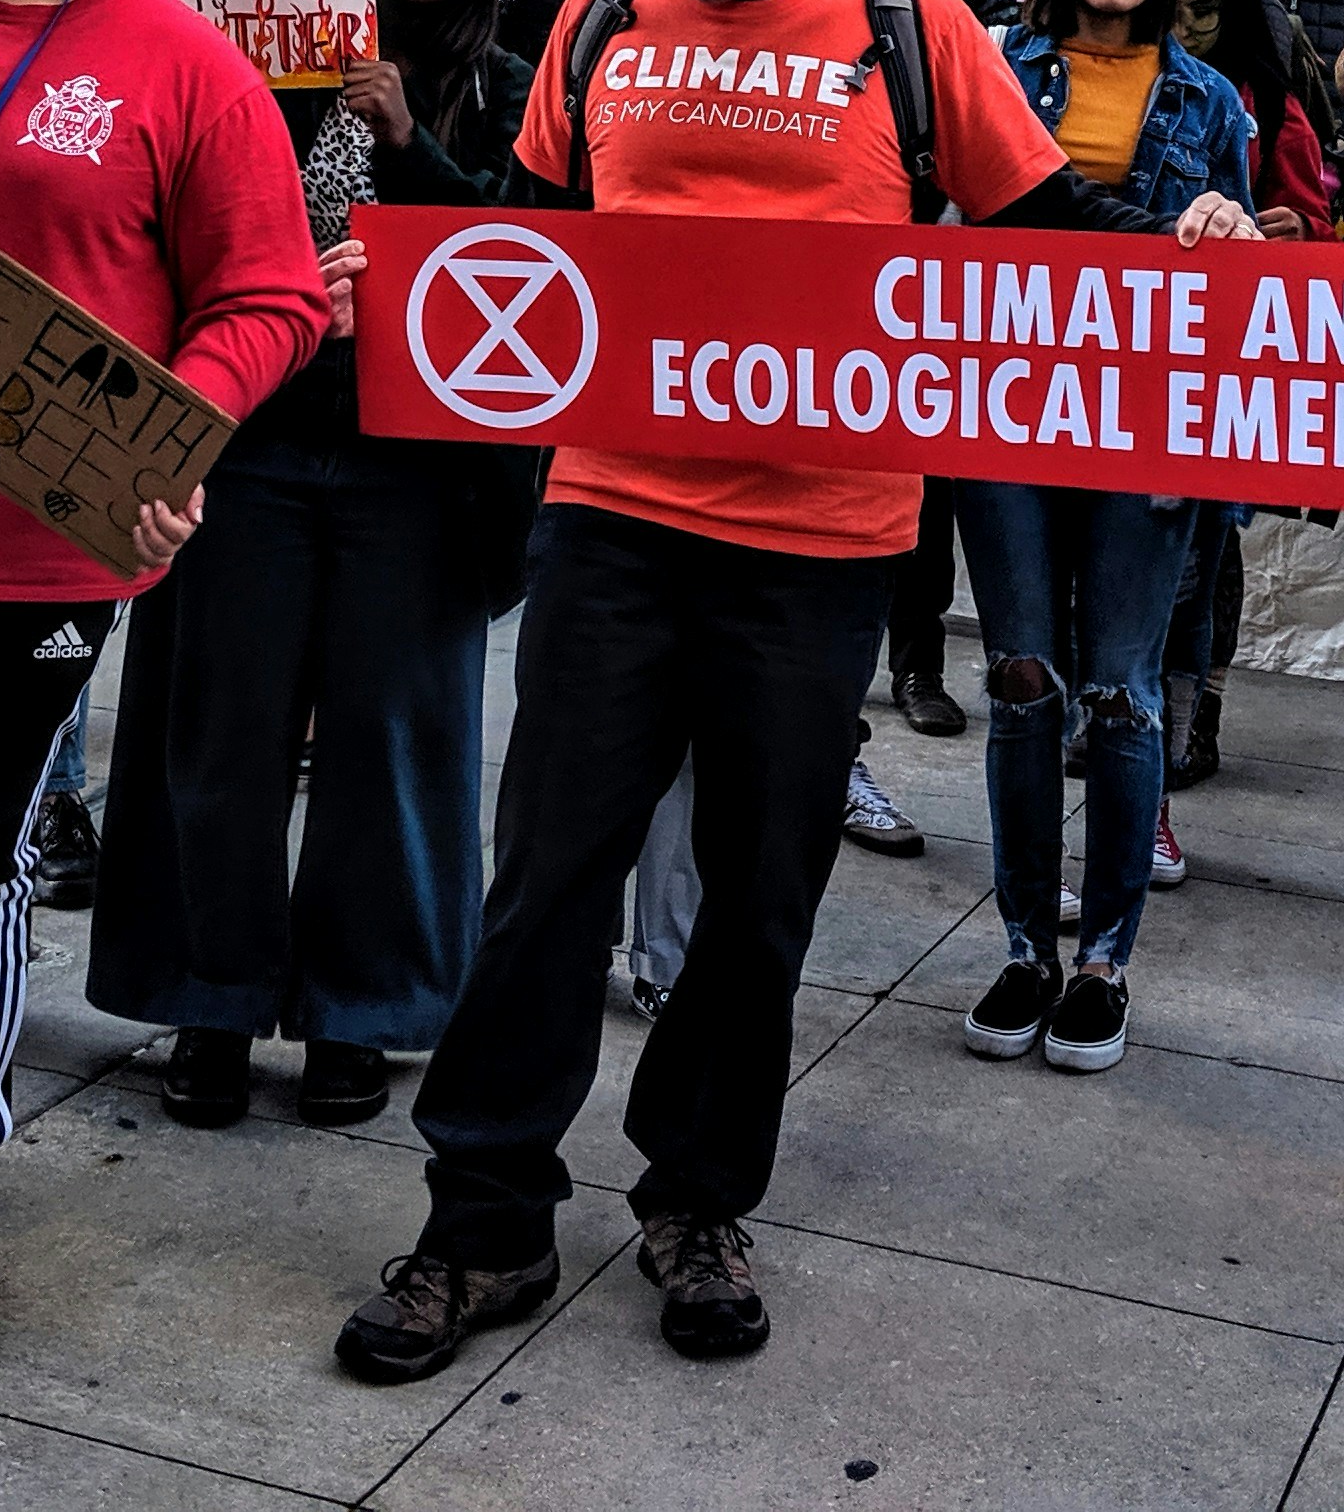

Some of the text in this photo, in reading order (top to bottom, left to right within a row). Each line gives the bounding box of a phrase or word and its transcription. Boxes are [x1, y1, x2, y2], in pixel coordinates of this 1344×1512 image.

[224, 12, 364, 75] TTER
[605, 46, 857, 107] CLIMATE
[597, 100, 841, 143] IS MY CANDIDATE
[873, 255, 1208, 357] CLIMATE
[23, 313, 214, 477] EARTH
[651, 338, 1135, 452] ECOLOGICAL
[33, 645, 93, 659] adidas
